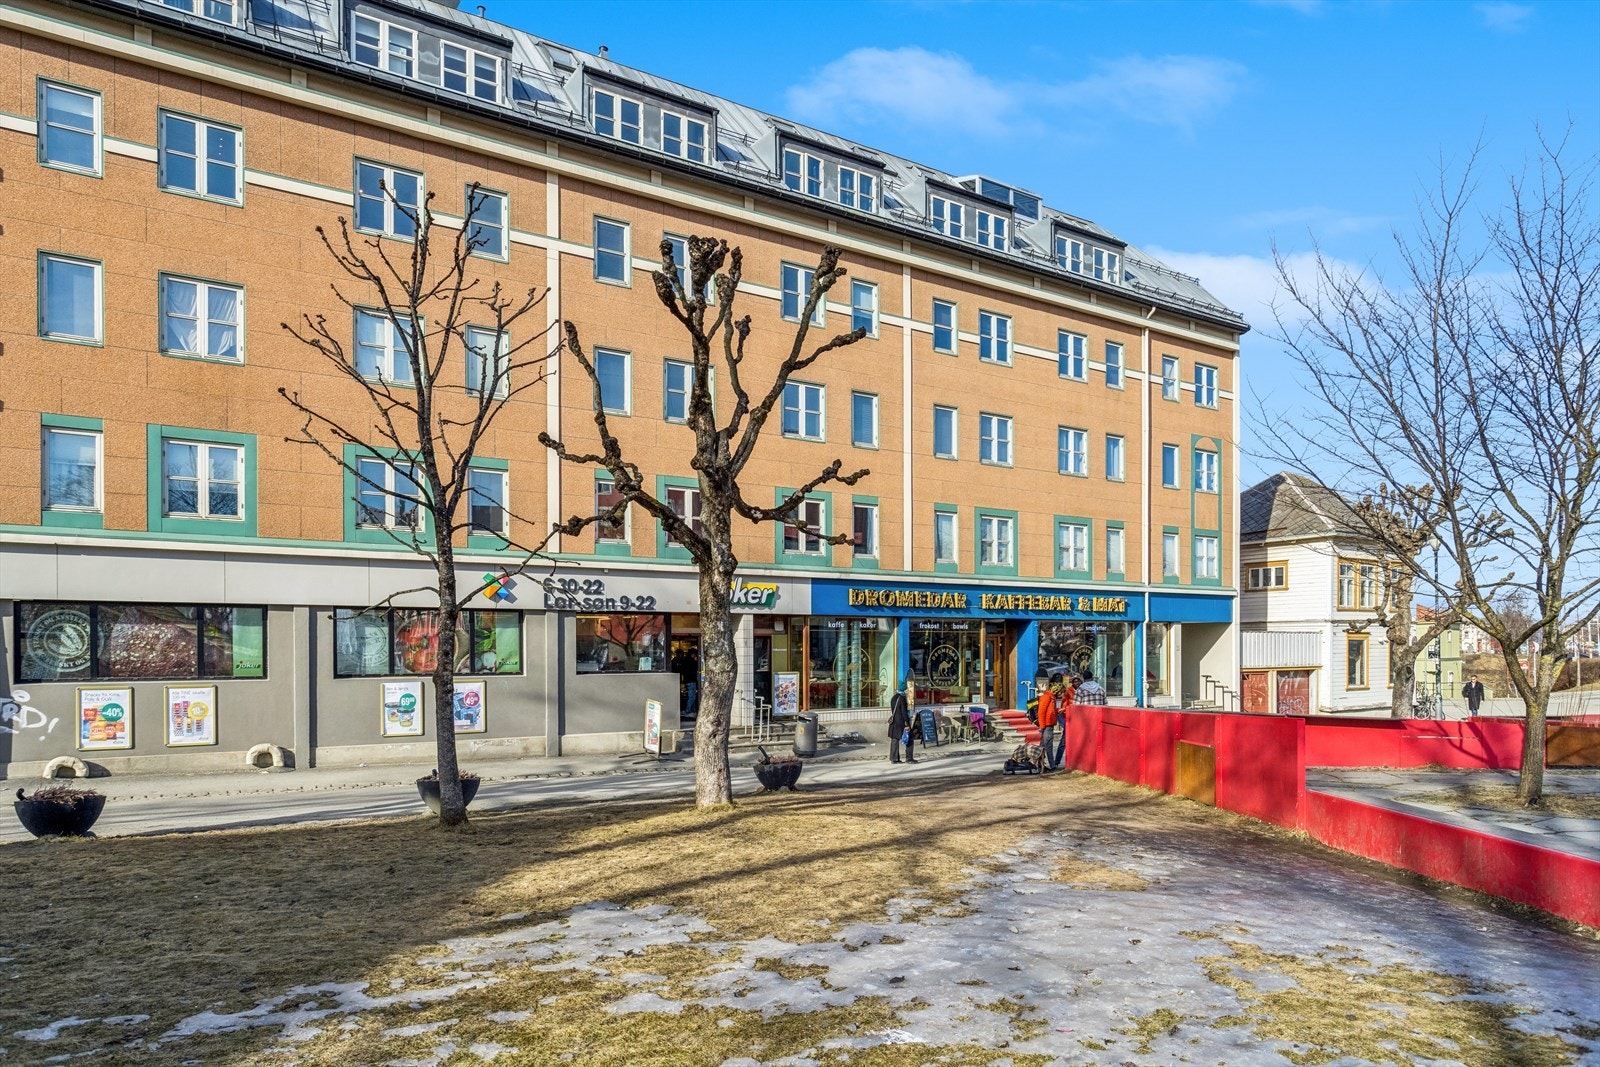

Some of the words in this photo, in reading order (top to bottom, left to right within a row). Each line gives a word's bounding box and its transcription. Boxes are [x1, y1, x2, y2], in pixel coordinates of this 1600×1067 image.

[729, 576, 774, 604] ker
[620, 595, 656, 611] 9-22
[848, 588, 967, 609] DROMEDAR
[981, 593, 1072, 611] KAFFEBAR
[1078, 596, 1091, 611] &
[1093, 597, 1128, 613] MAT
[102, 708, 123, 717] -40%
